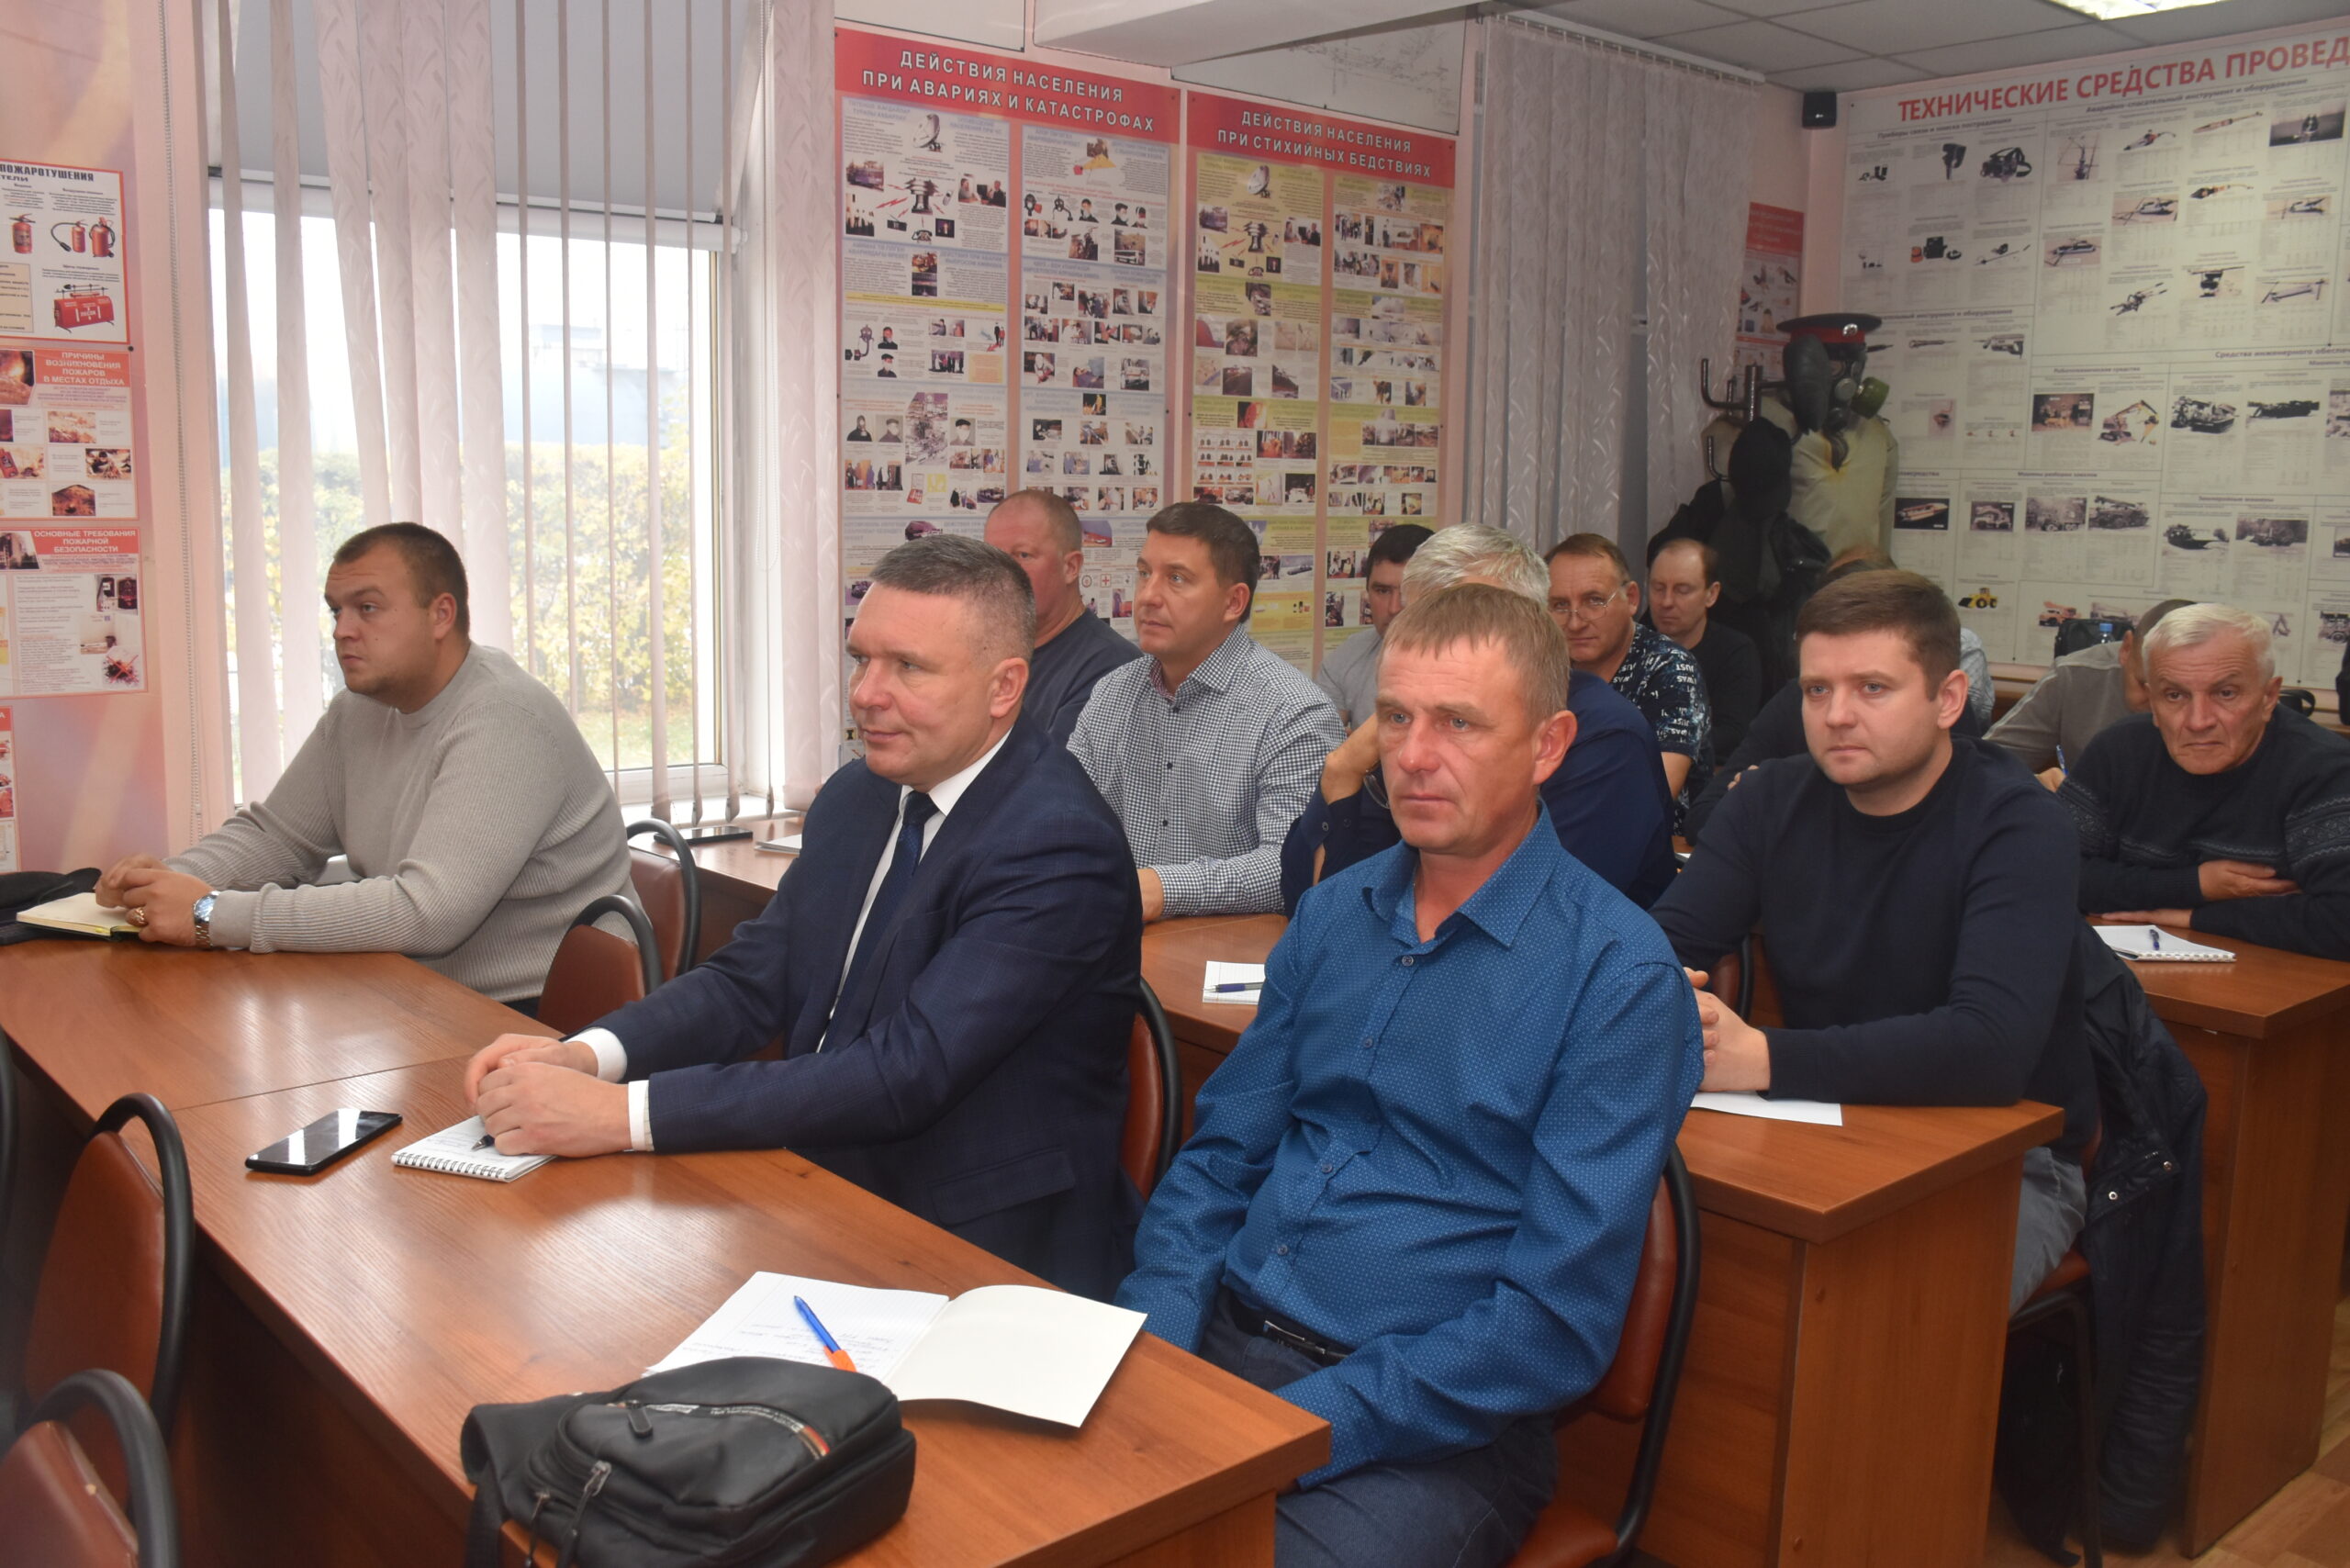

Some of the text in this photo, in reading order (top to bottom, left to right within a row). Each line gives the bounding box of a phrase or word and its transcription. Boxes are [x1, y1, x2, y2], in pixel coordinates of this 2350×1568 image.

[900, 50, 1123, 103] ДЕЙСТВИЯ НАСЕЛЕНИЯ
[1897, 36, 2350, 122] ТЕХНИЧЕСКИЕ СРЕДСТВА ПРОВЕД
[862, 70, 1154, 131] ПРИ АВАРИЯХ И КАТАСТРОФАХ
[1241, 110, 1411, 152] ДЕЙСТВИЯ НАСЕЛЕНИЯ
[1217, 129, 1431, 177] ПРИ СТИХИЙНЫХ БЕДСТВИЯХ
[0, 164, 94, 181] ПОЖАРОТУШЕНИЯ
[45, 359, 121, 369] ВОЗНИКНОВЕНИЯ
[62, 352, 105, 361] ПРИЧИНЫ
[51, 375, 87, 384] МЕСТАХ
[88, 377, 125, 386] ОТДЫХА
[62, 368, 106, 376] ПОЖАРОВ
[1675, 663, 1695, 672] JUST
